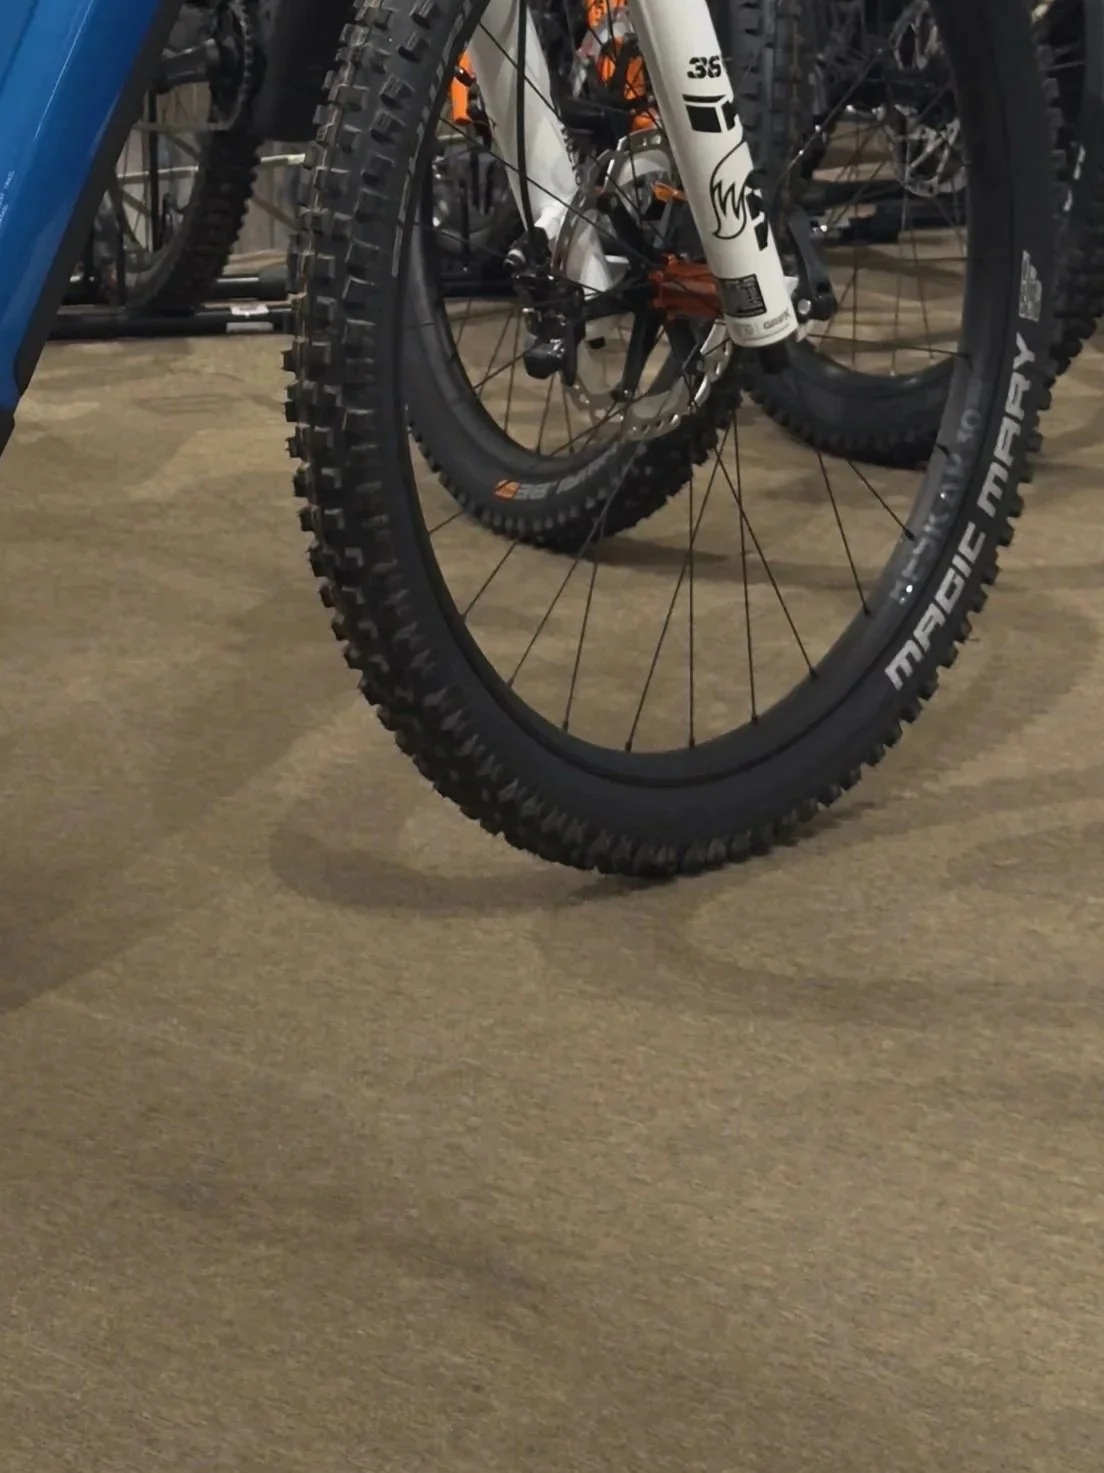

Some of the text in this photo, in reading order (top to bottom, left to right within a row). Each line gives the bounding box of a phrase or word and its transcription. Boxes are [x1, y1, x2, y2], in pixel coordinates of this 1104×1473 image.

[686, 55, 722, 80] 36
[884, 331, 1036, 692] MAGIC MARY
